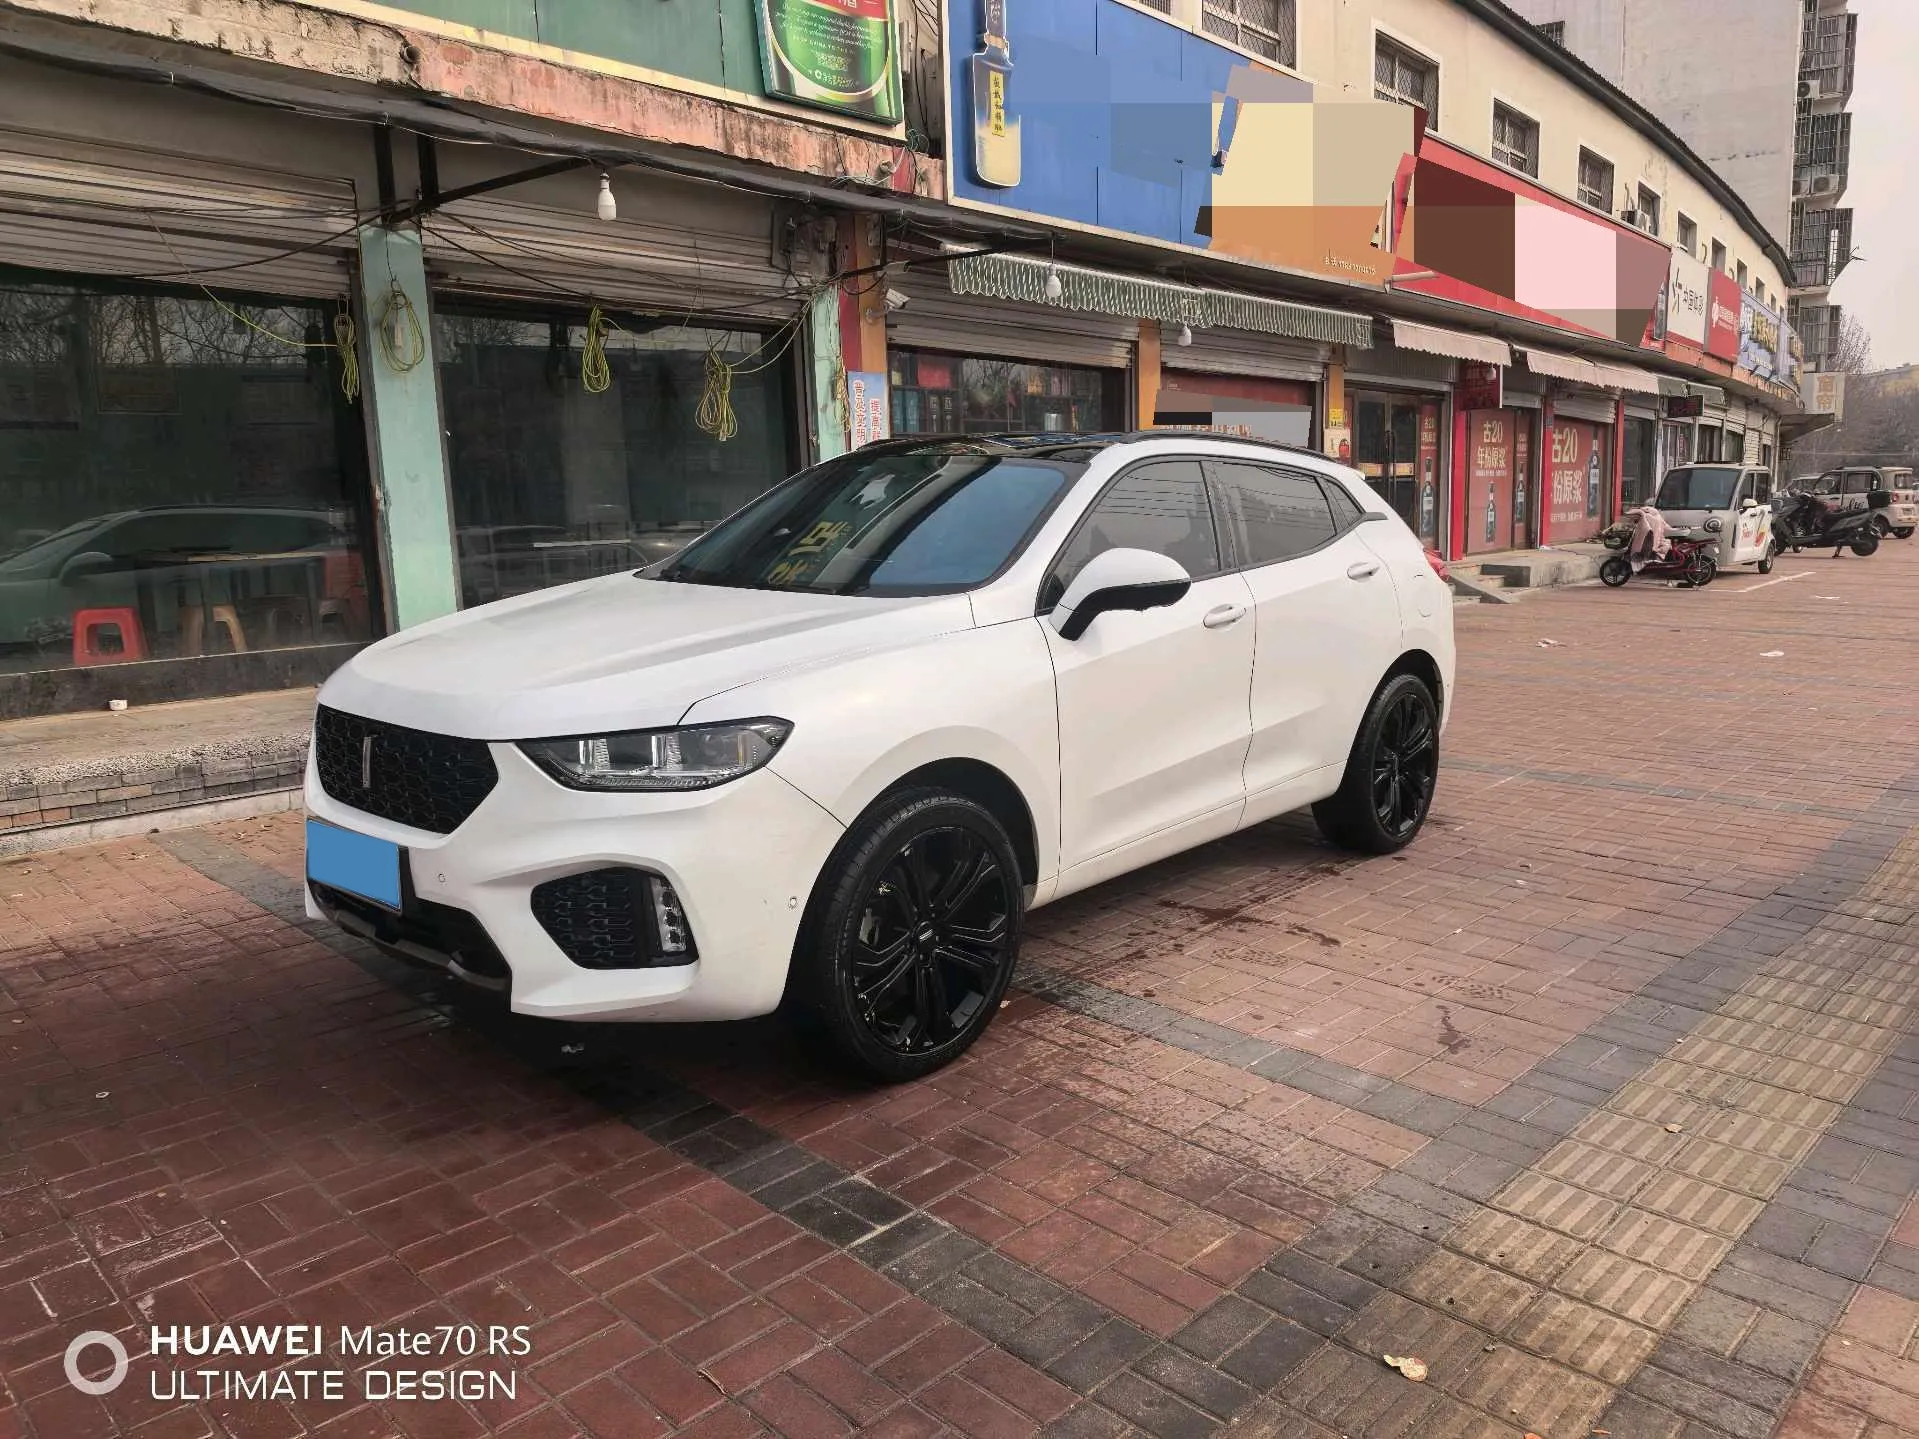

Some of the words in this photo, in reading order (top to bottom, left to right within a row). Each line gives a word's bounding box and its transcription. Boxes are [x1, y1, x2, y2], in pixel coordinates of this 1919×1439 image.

[1483, 421, 1504, 443] 古20
[1551, 427, 1578, 464] 古20
[1477, 446, 1507, 469] 年份原浆
[1551, 470, 1582, 504] 份原浆
